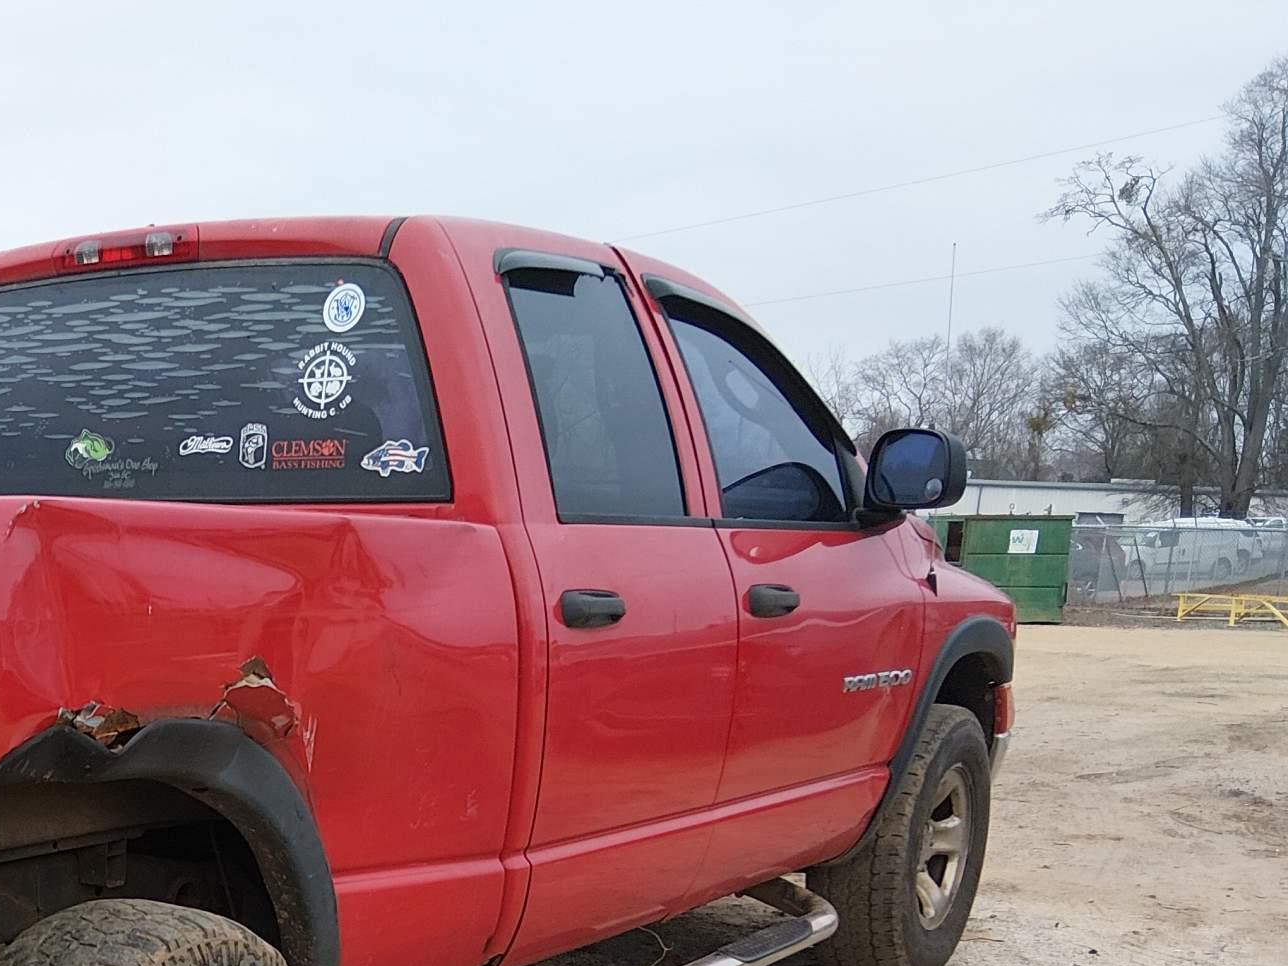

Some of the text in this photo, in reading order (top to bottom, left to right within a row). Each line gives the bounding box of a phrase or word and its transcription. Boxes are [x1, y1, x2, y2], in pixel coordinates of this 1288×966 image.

[298, 342, 357, 370] RABBIT HOUND
[292, 397, 327, 419] HUNTING
[272, 459, 346, 470] BASS FISHING
[842, 674, 877, 693] RAM
